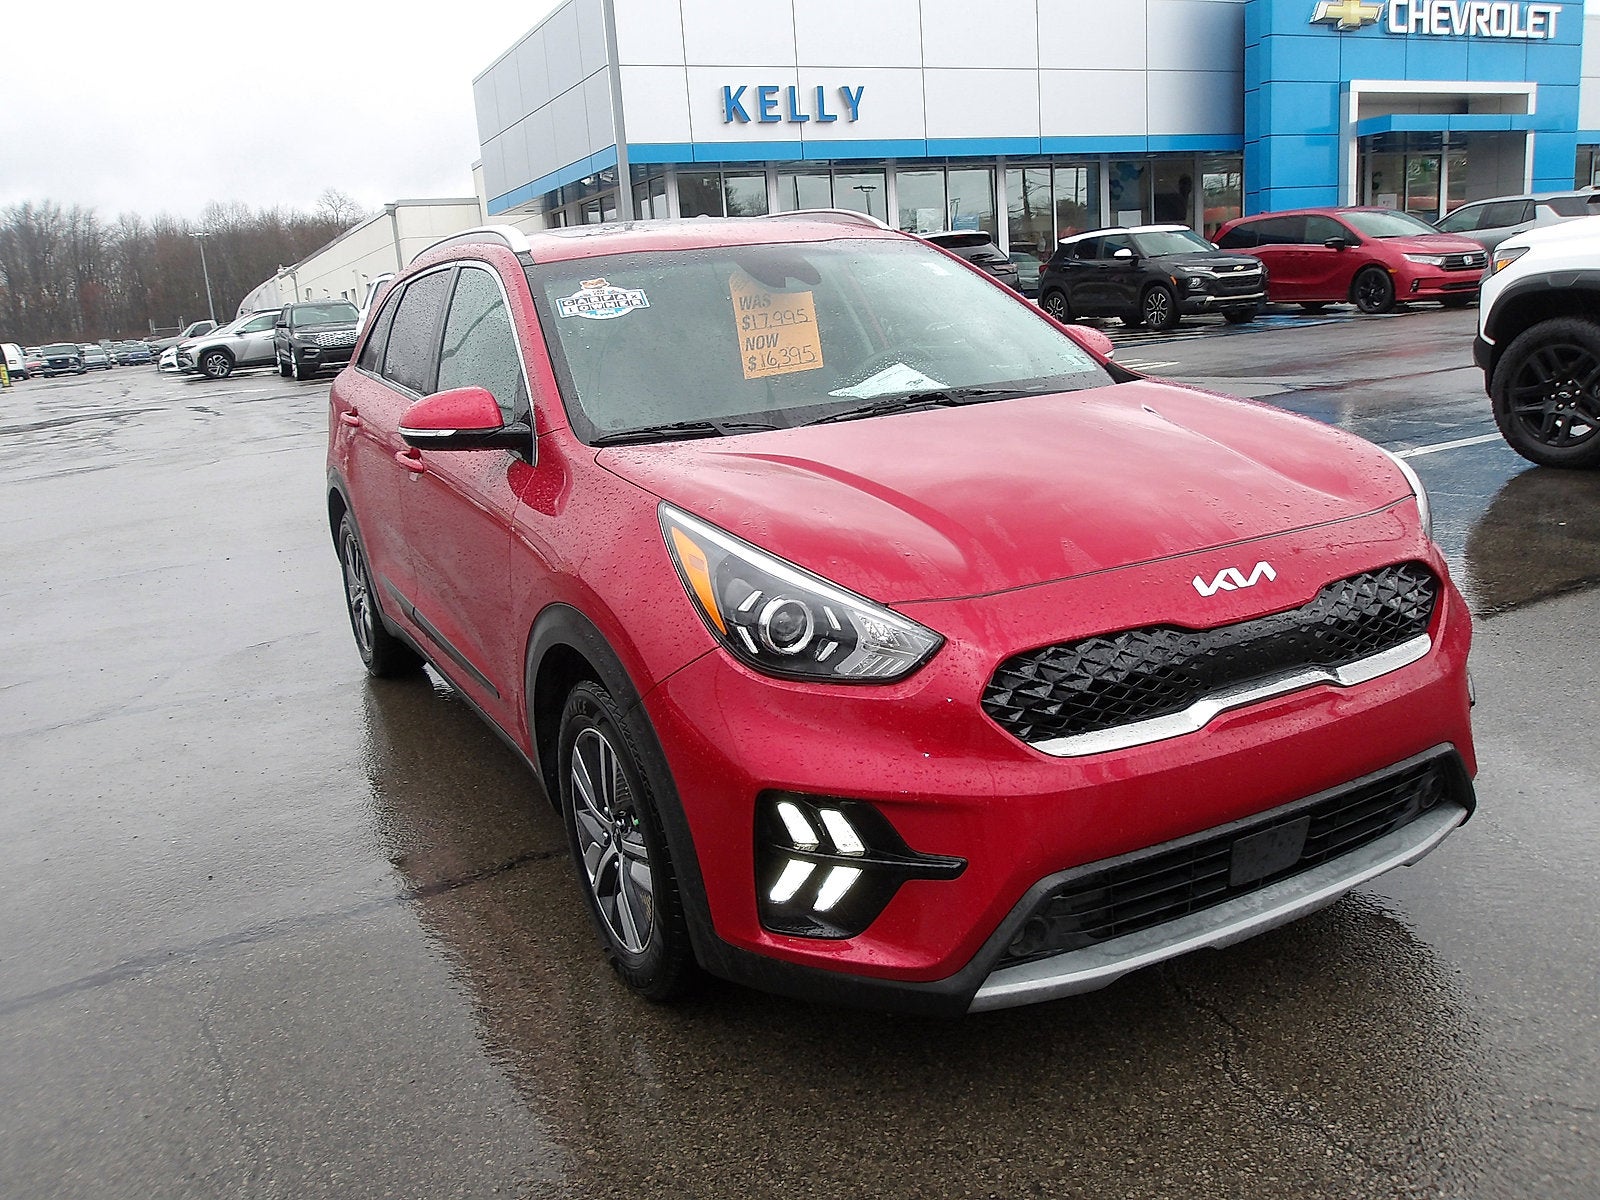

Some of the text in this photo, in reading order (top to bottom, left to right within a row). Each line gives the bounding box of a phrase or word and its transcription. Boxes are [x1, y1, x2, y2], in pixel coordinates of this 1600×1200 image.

[1386, 0, 1562, 39] CHEVROLET
[721, 85, 865, 124] KELLY
[739, 294, 771, 310] WAS
[742, 309, 812, 331] $17,995
[745, 333, 779, 351] NOW
[748, 345, 819, 372] $16,395
[1192, 561, 1277, 597] KIA
